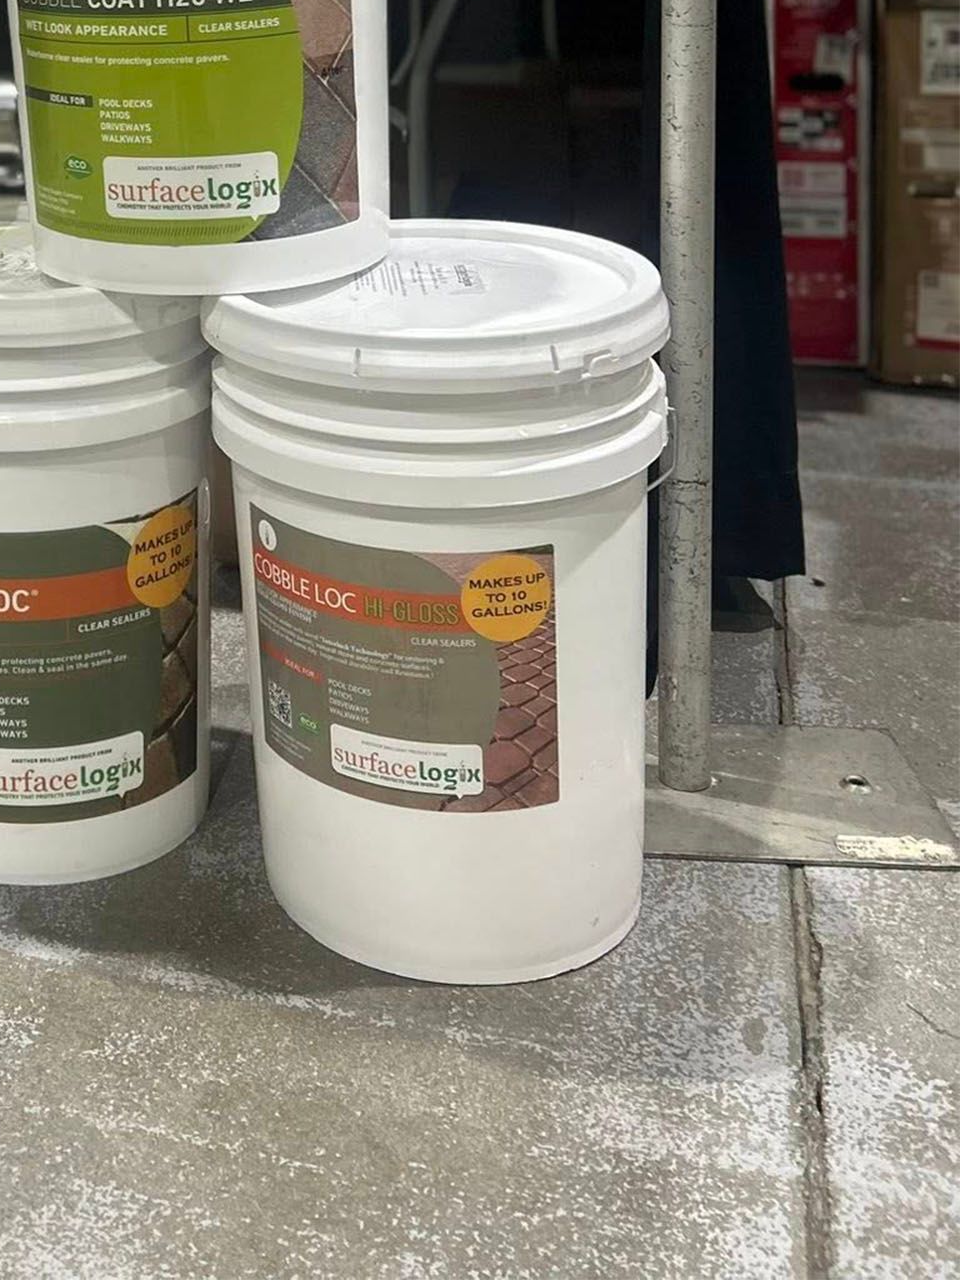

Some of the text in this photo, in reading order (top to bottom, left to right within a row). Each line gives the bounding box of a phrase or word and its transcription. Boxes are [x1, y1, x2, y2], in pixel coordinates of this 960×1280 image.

[44, 22, 72, 35] LOOK
[74, 24, 168, 37] APPEARANCE
[198, 22, 234, 34] CLEAR
[234, 17, 280, 30] SEALERS
[153, 55, 193, 65] concrete
[70, 96, 86, 106] FOR
[99, 99, 121, 108] POOL
[123, 99, 152, 108] DECKS
[100, 111, 130, 120] PATIOS
[100, 122, 151, 132] DRIVEWAYS
[101, 134, 152, 144] WALKWAYS
[108, 170, 277, 209] surfacelogix
[135, 528, 179, 555] MAKES
[150, 544, 182, 566] TO 10
[254, 552, 311, 600] COBBLE
[315, 583, 357, 613] LOC
[363, 593, 459, 626] HI-GLOSS
[468, 573, 545, 589] MAKES UP
[486, 591, 527, 603] TO 10
[471, 601, 547, 618] GALLONS!
[78, 620, 110, 633] CLEAR
[112, 608, 151, 626] SEALERS
[410, 636, 477, 648] CLEAR SEALERS
[1, 657, 44, 666] protecting
[46, 654, 82, 664] concrete
[334, 747, 481, 790] surfacelogix
